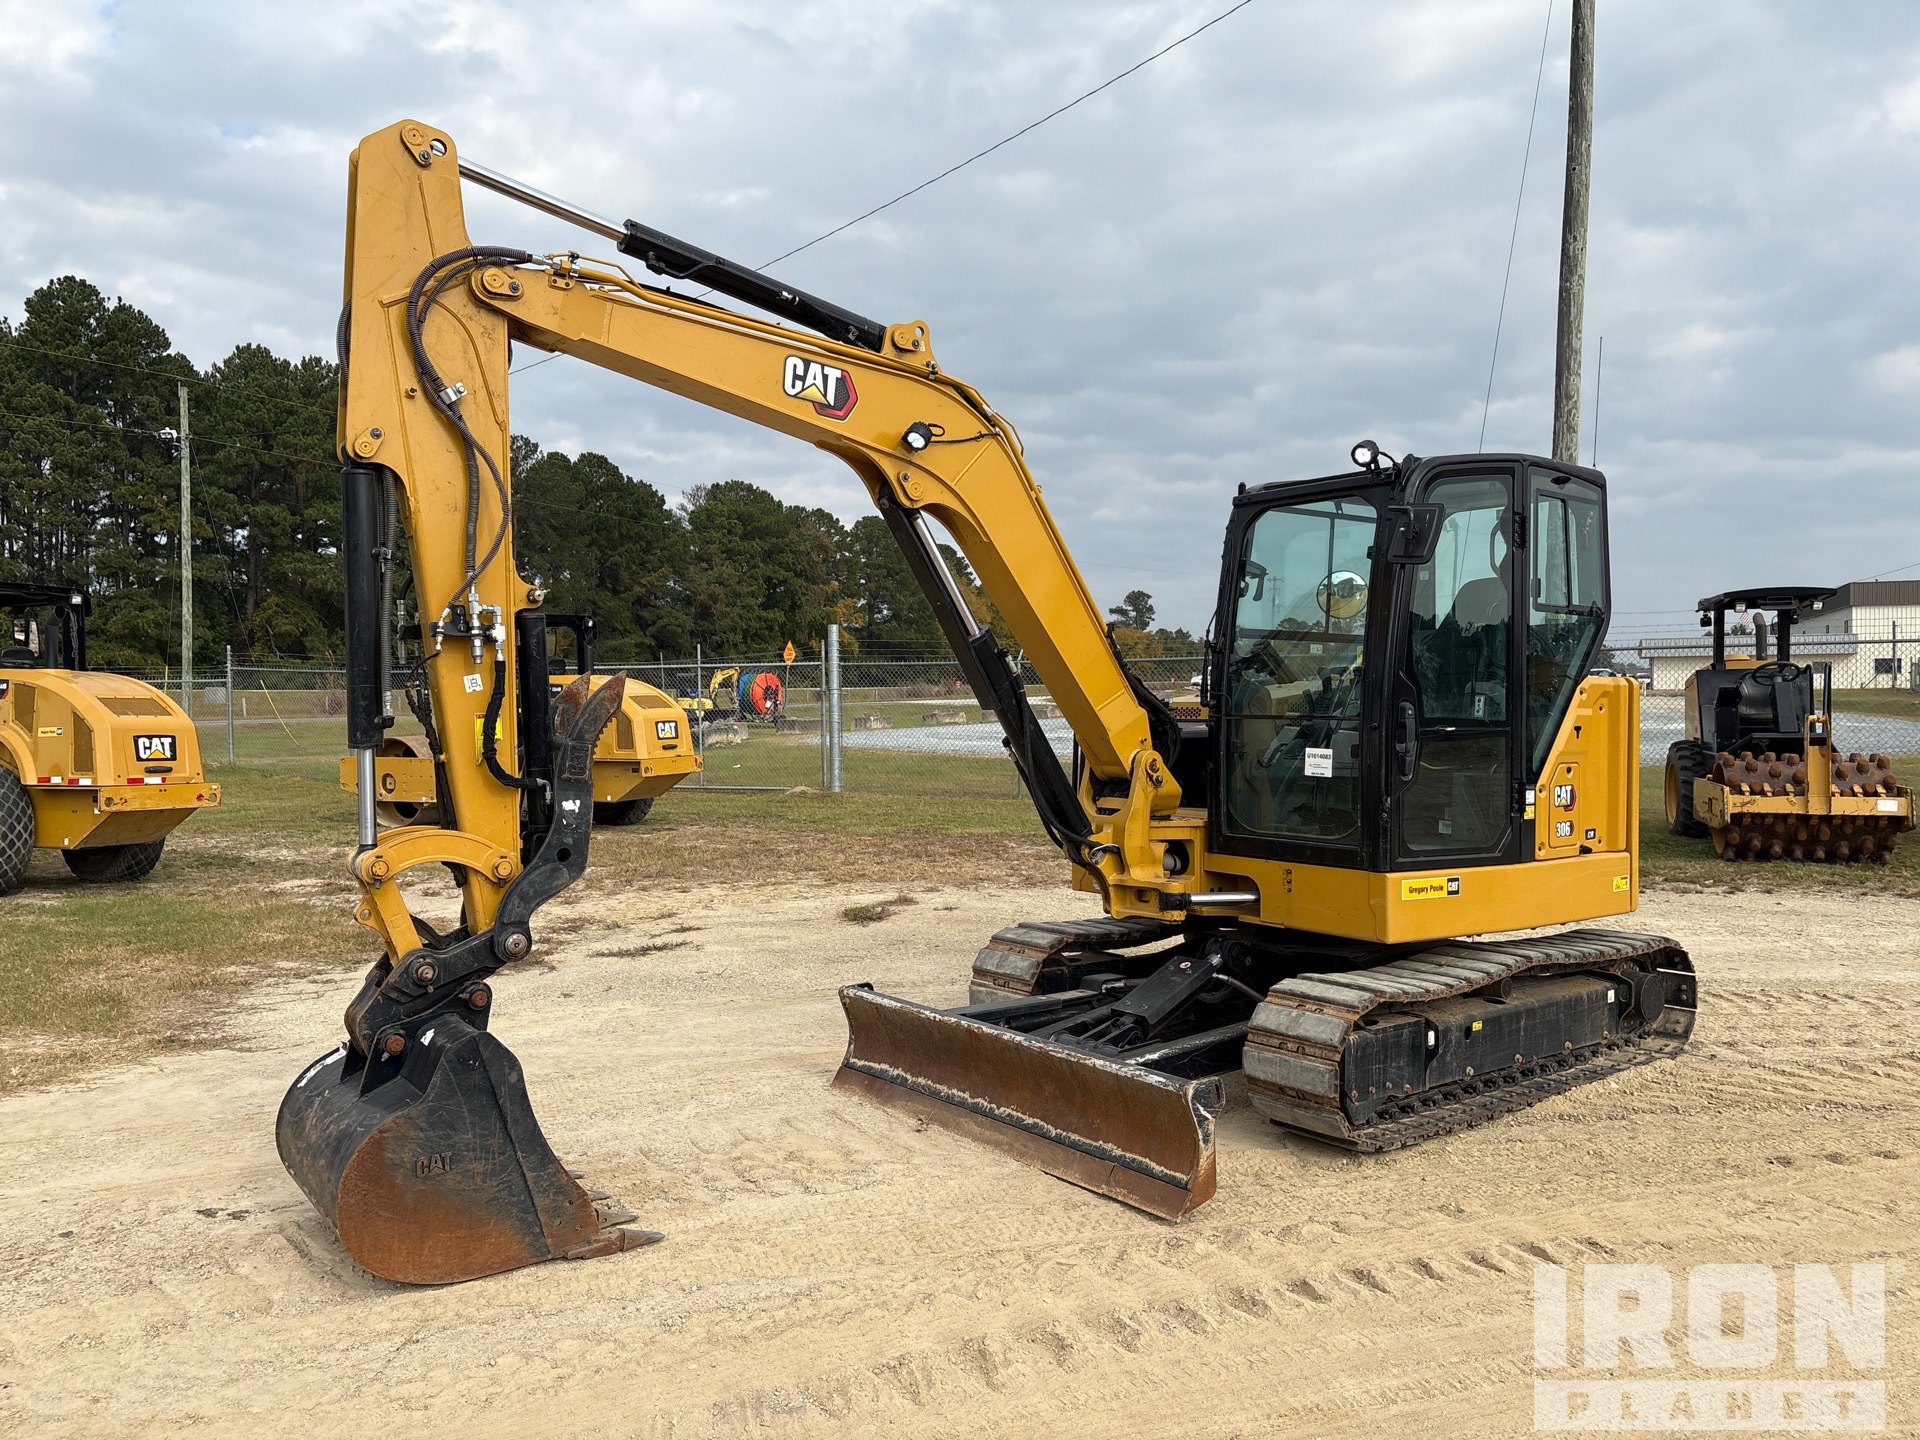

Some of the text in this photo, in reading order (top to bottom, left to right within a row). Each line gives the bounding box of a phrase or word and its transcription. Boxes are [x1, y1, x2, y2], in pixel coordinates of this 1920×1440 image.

[785, 356, 842, 406] CAT
[657, 721, 676, 738] CAT
[138, 737, 172, 759] CAT
[1554, 785, 1572, 807] CAT
[1556, 821, 1571, 837] 306
[1408, 881, 1459, 895] Gregory Poole CAT
[416, 1151, 453, 1179] CAT
